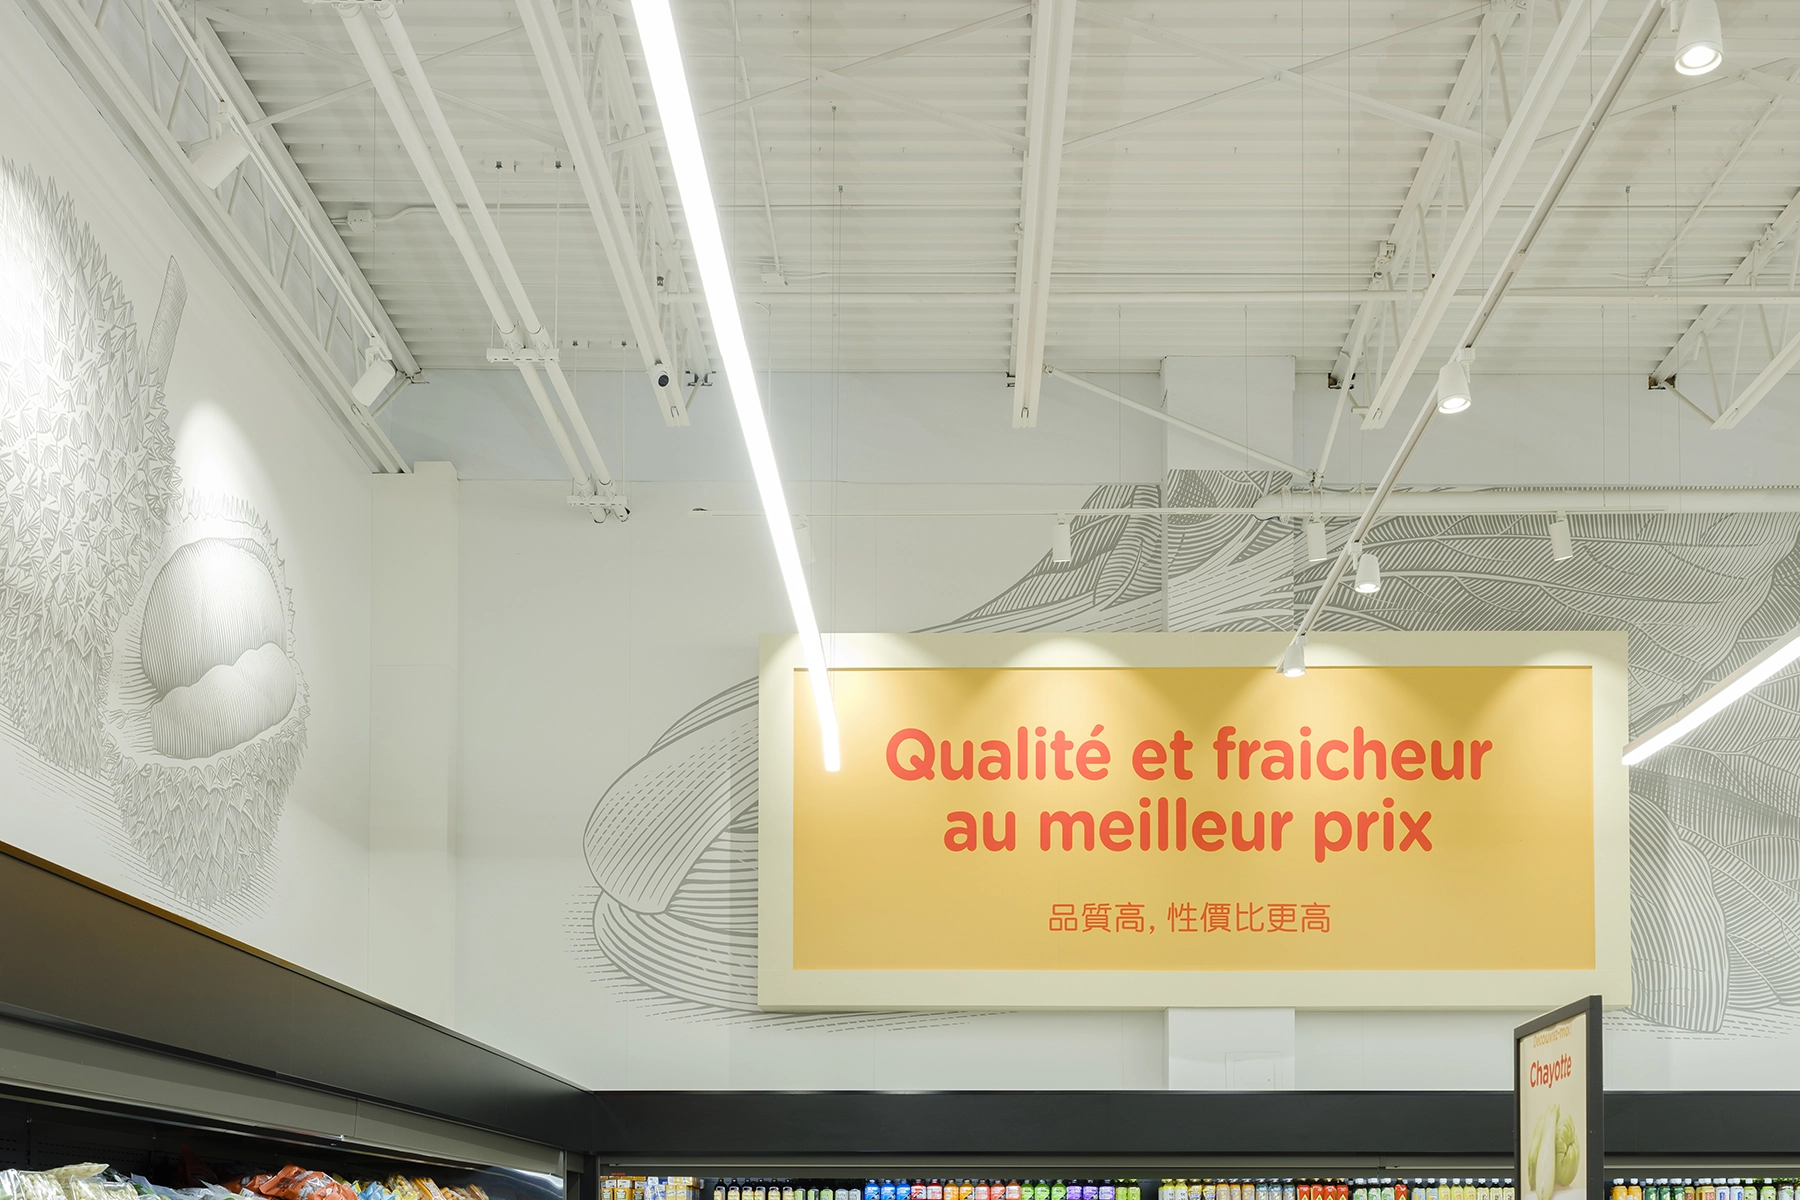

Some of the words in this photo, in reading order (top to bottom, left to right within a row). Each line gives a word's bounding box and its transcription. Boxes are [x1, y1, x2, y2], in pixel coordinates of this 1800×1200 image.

[886, 723, 1111, 782] Qualité
[1132, 730, 1193, 781] et
[1213, 725, 1493, 781] fraicheur
[943, 810, 1017, 853] au
[1040, 797, 1294, 853] meilleur
[1314, 797, 1433, 864] prix
[1049, 901, 1332, 936] 品質高,性價比更高
[1530, 1053, 1572, 1089] Chayotte
